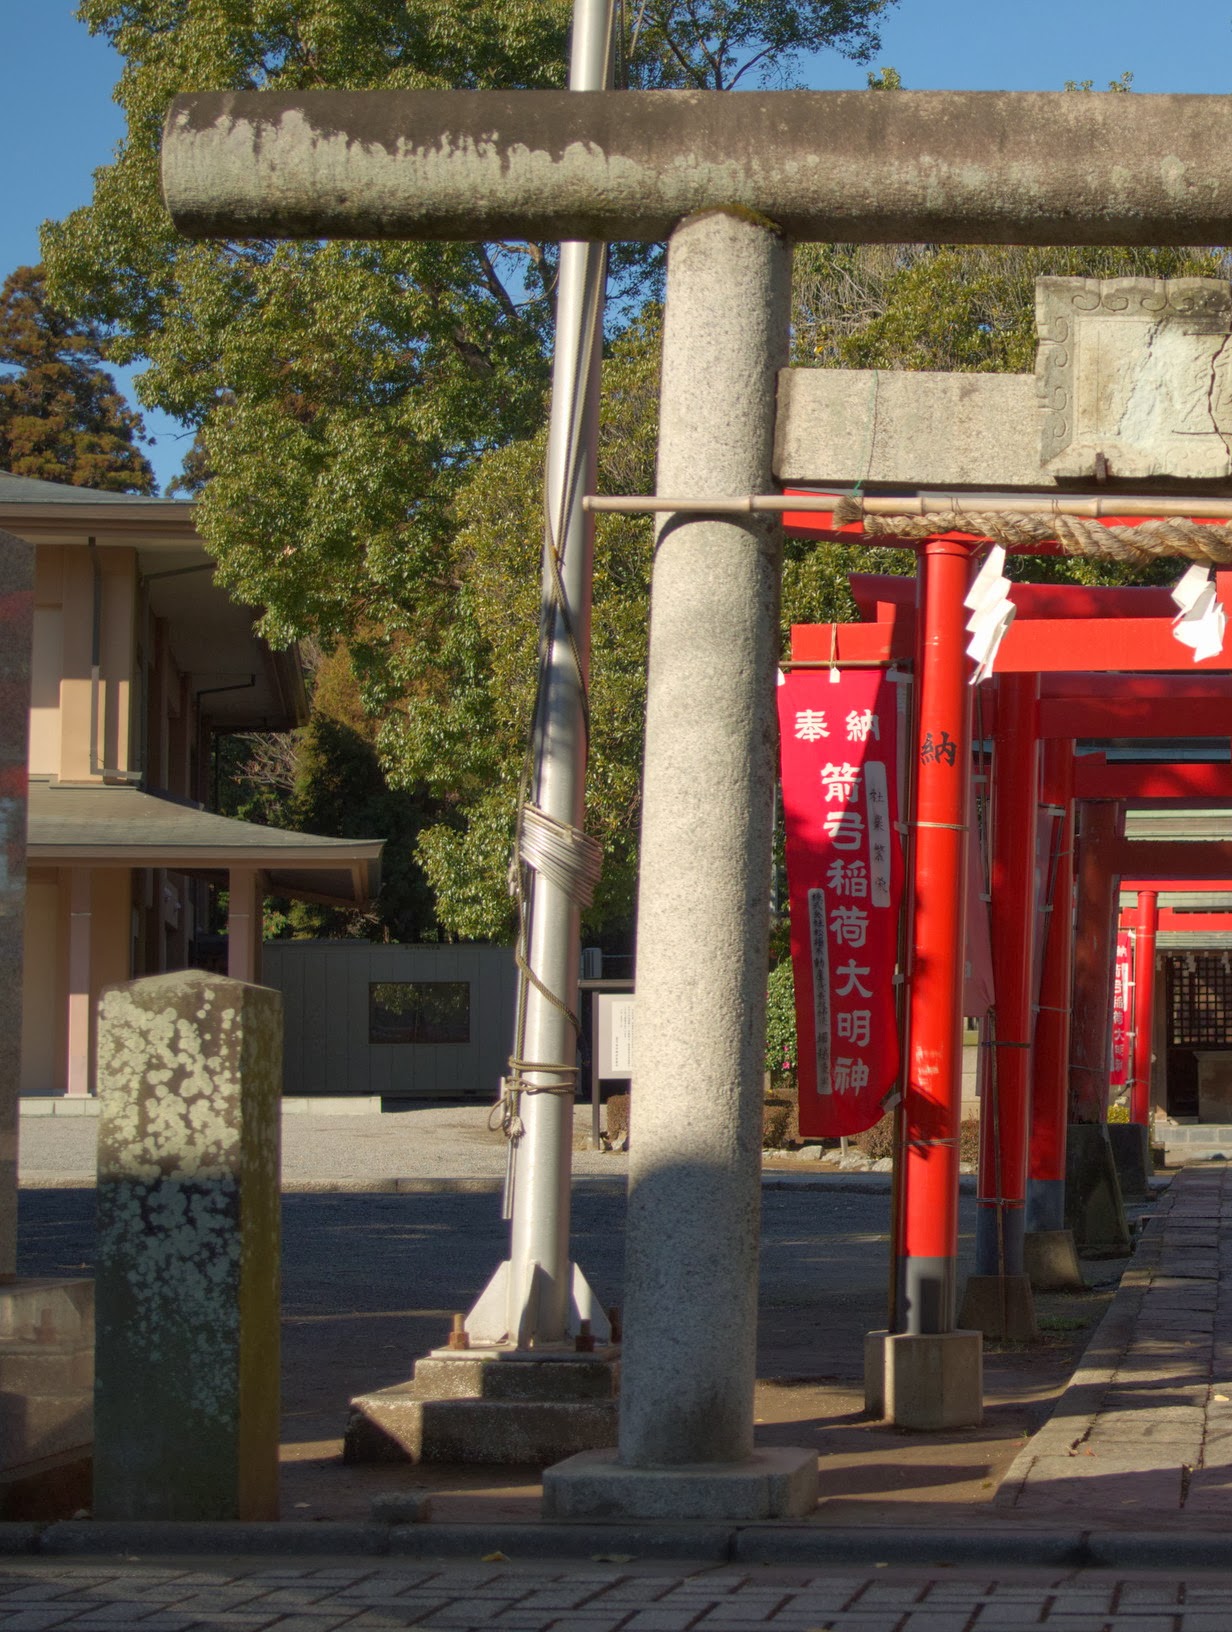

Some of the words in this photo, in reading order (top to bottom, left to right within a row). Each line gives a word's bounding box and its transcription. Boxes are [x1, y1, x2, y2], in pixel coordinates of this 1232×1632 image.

[794, 708, 881, 742] 奉納
[919, 732, 958, 768] 納
[820, 761, 872, 1097] 箭弓稲荷大明神
